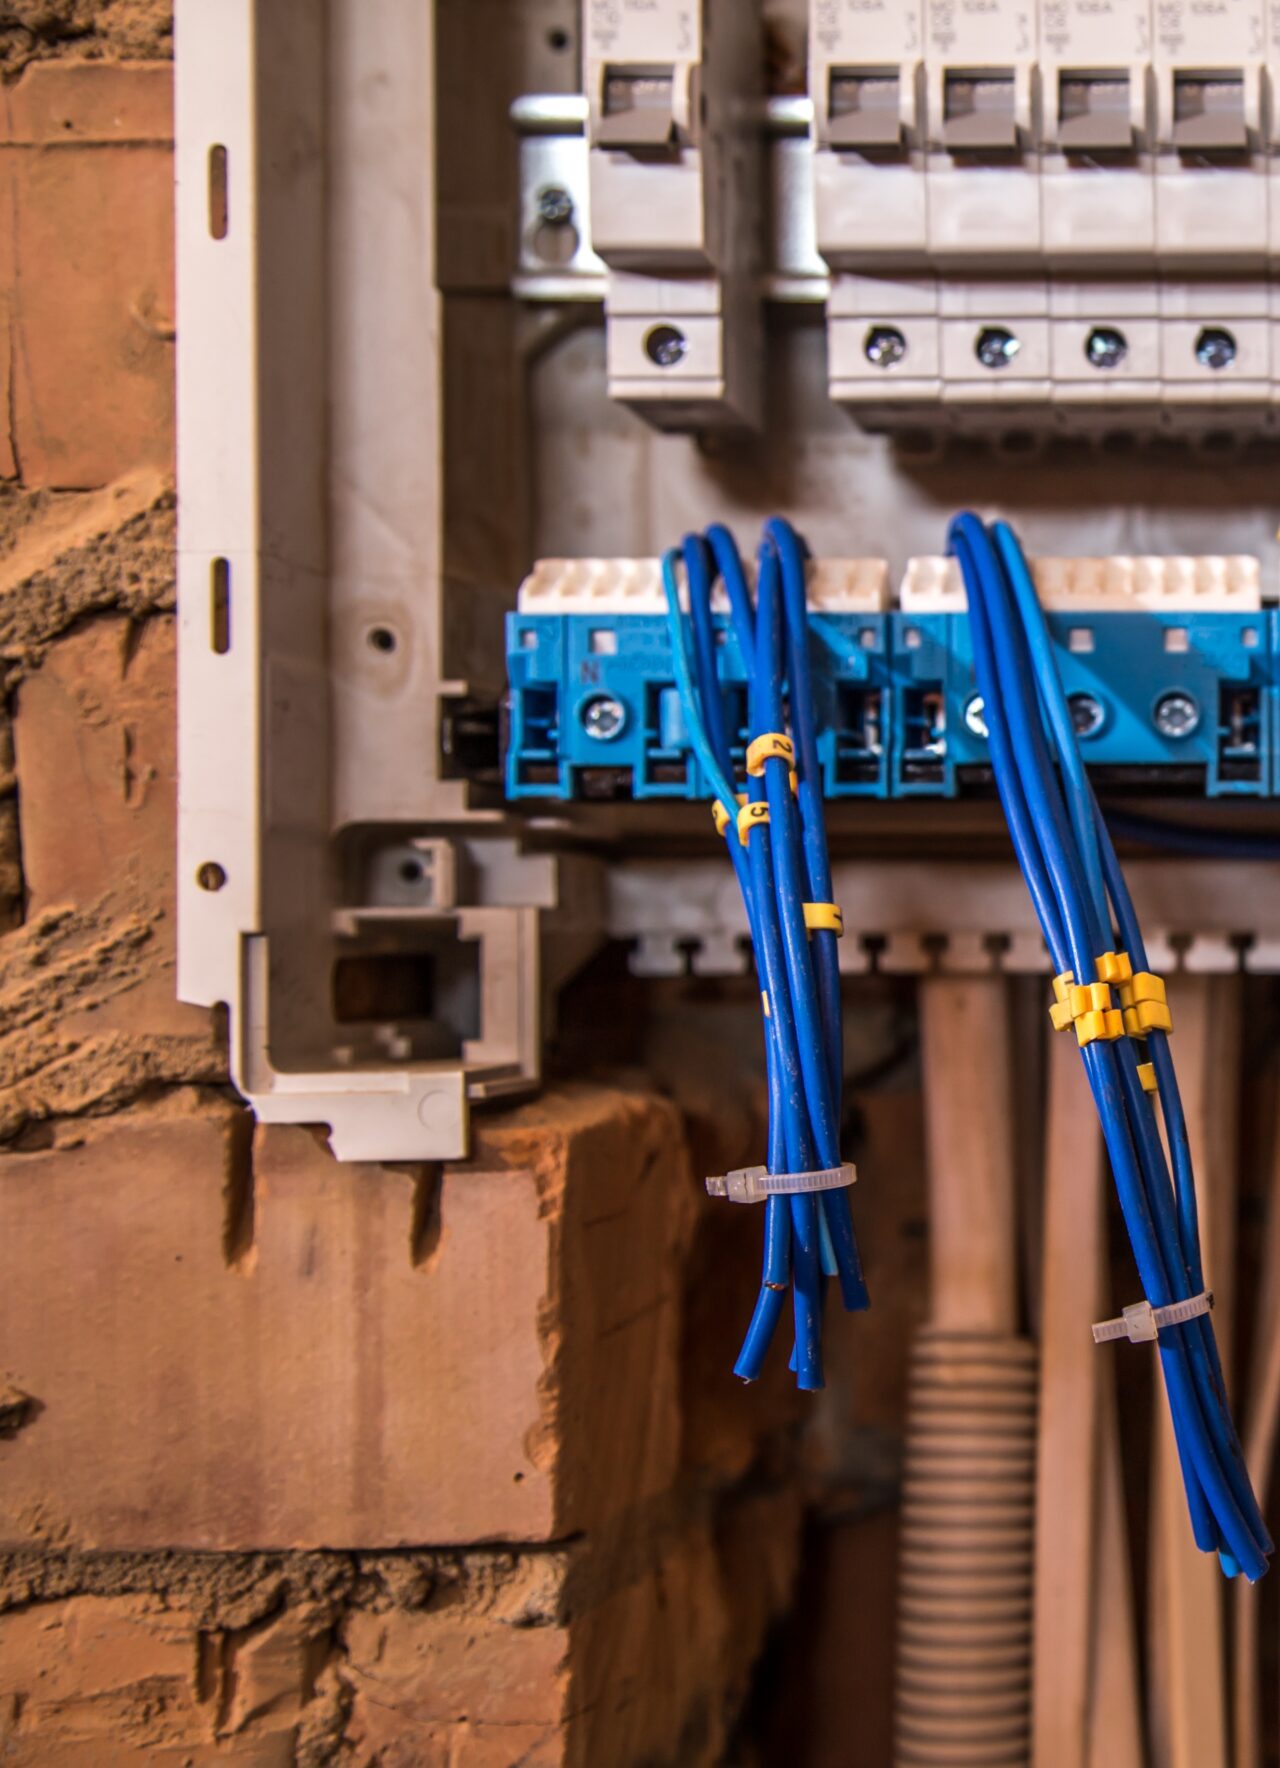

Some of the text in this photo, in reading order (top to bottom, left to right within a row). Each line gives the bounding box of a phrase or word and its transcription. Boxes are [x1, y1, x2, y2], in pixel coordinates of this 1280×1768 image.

[581, 659, 600, 683] N
[772, 739, 792, 753] 2
[750, 806, 769, 818] 5
